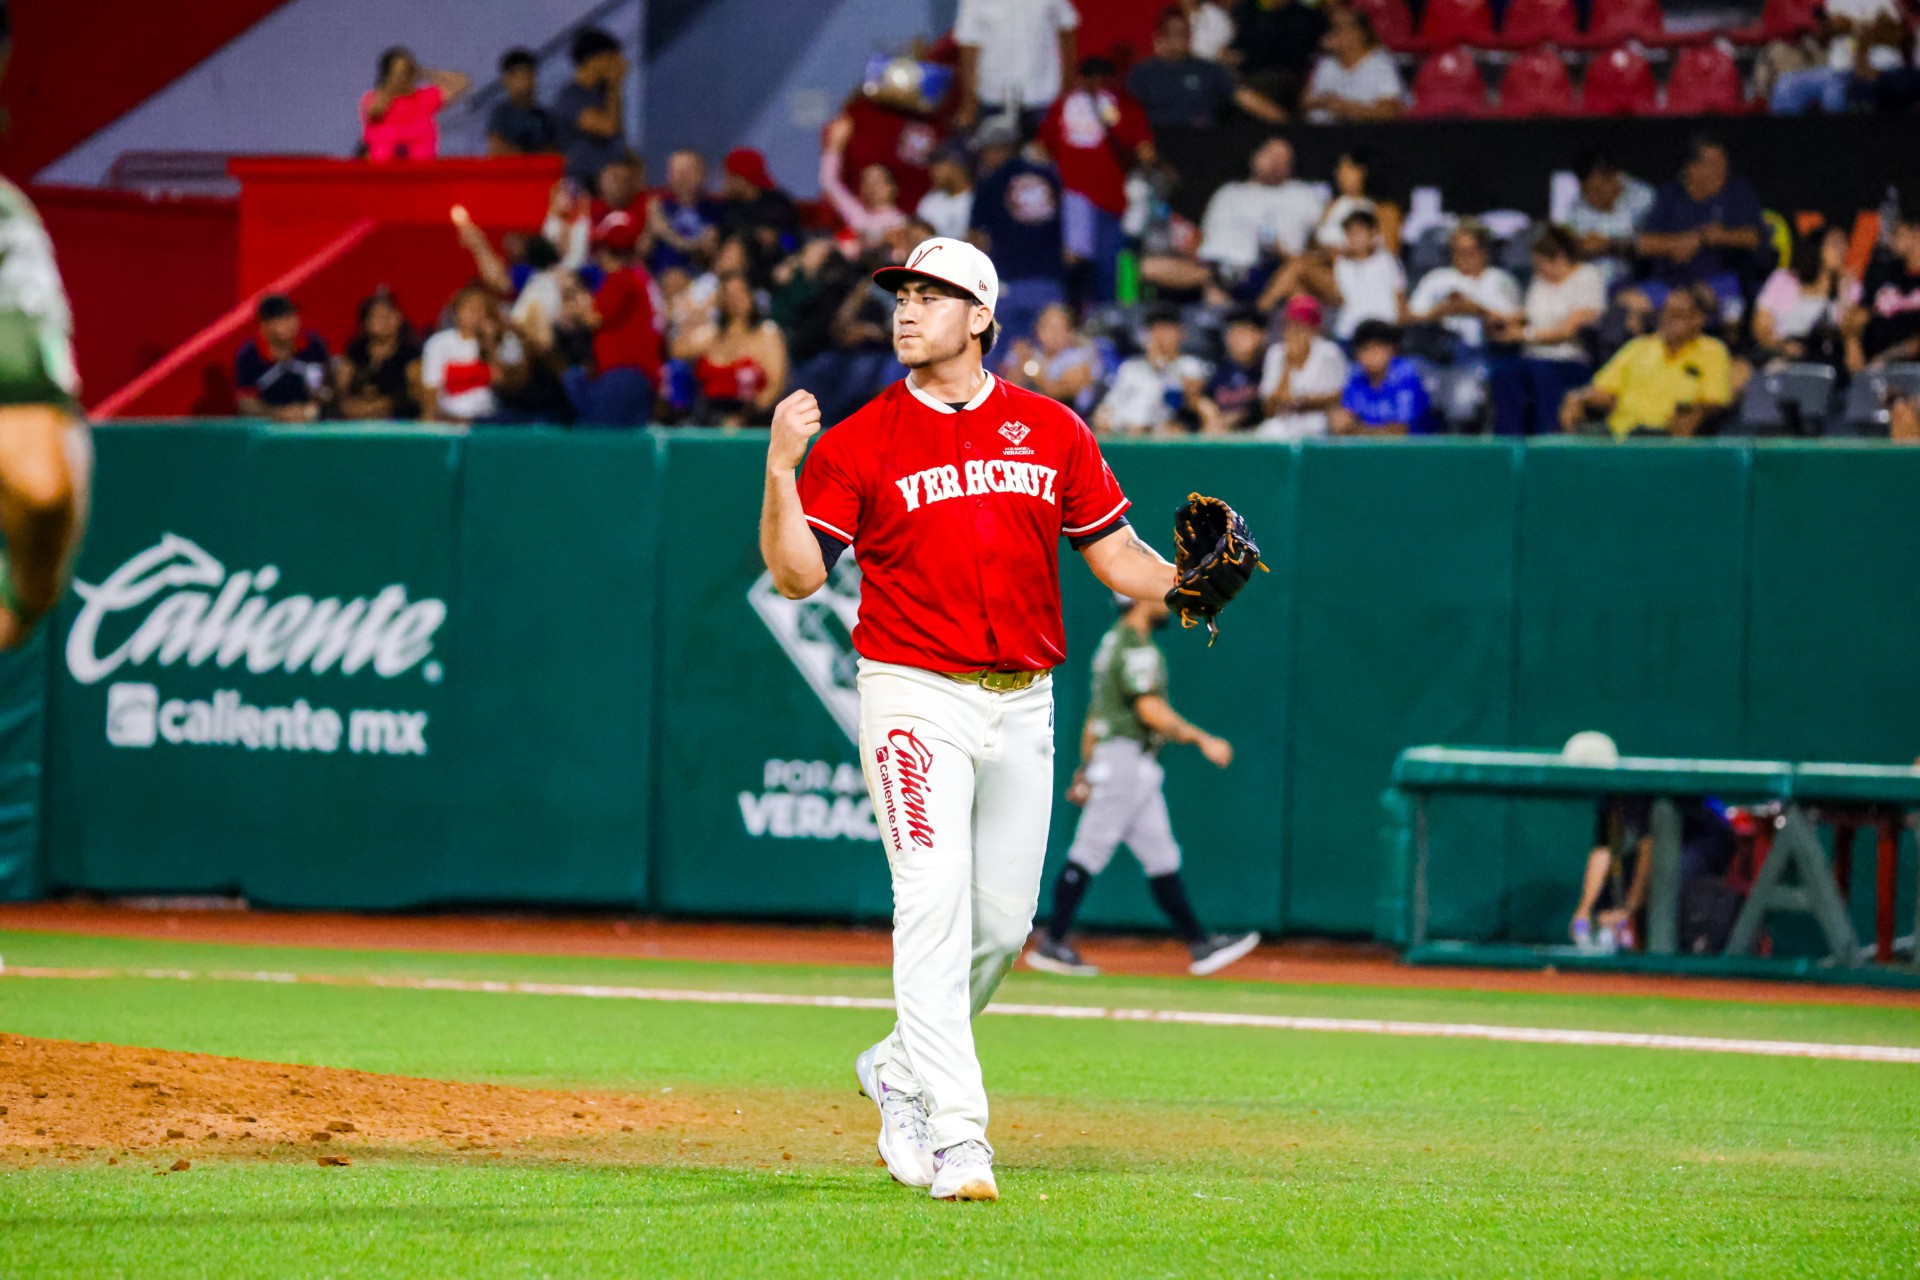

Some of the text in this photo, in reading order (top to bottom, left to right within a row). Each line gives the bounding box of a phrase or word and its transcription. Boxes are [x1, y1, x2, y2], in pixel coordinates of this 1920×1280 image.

[895, 459, 1058, 512] VERACRUZ
[66, 532, 447, 685] Caliente
[737, 791, 882, 842] VERAC
[880, 764, 903, 851] caliente.mx
[888, 727, 935, 848] Caliente
